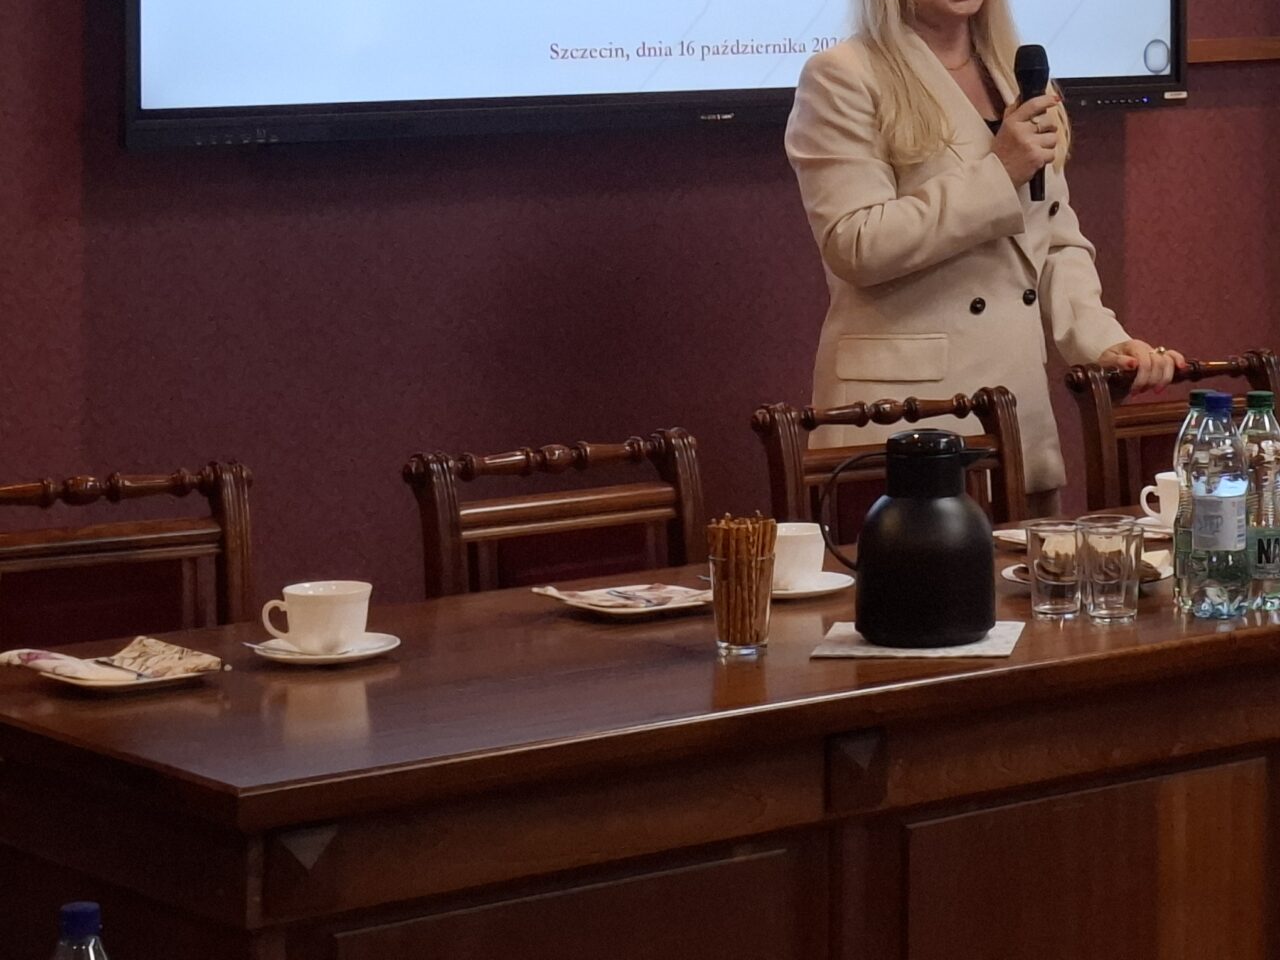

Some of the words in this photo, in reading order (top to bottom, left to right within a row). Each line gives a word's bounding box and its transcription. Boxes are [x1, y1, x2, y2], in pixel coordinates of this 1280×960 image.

[549, 41, 631, 61] Szczecin,
[635, 40, 673, 58] dnia
[678, 39, 696, 57] 16
[700, 37, 807, 61] października
